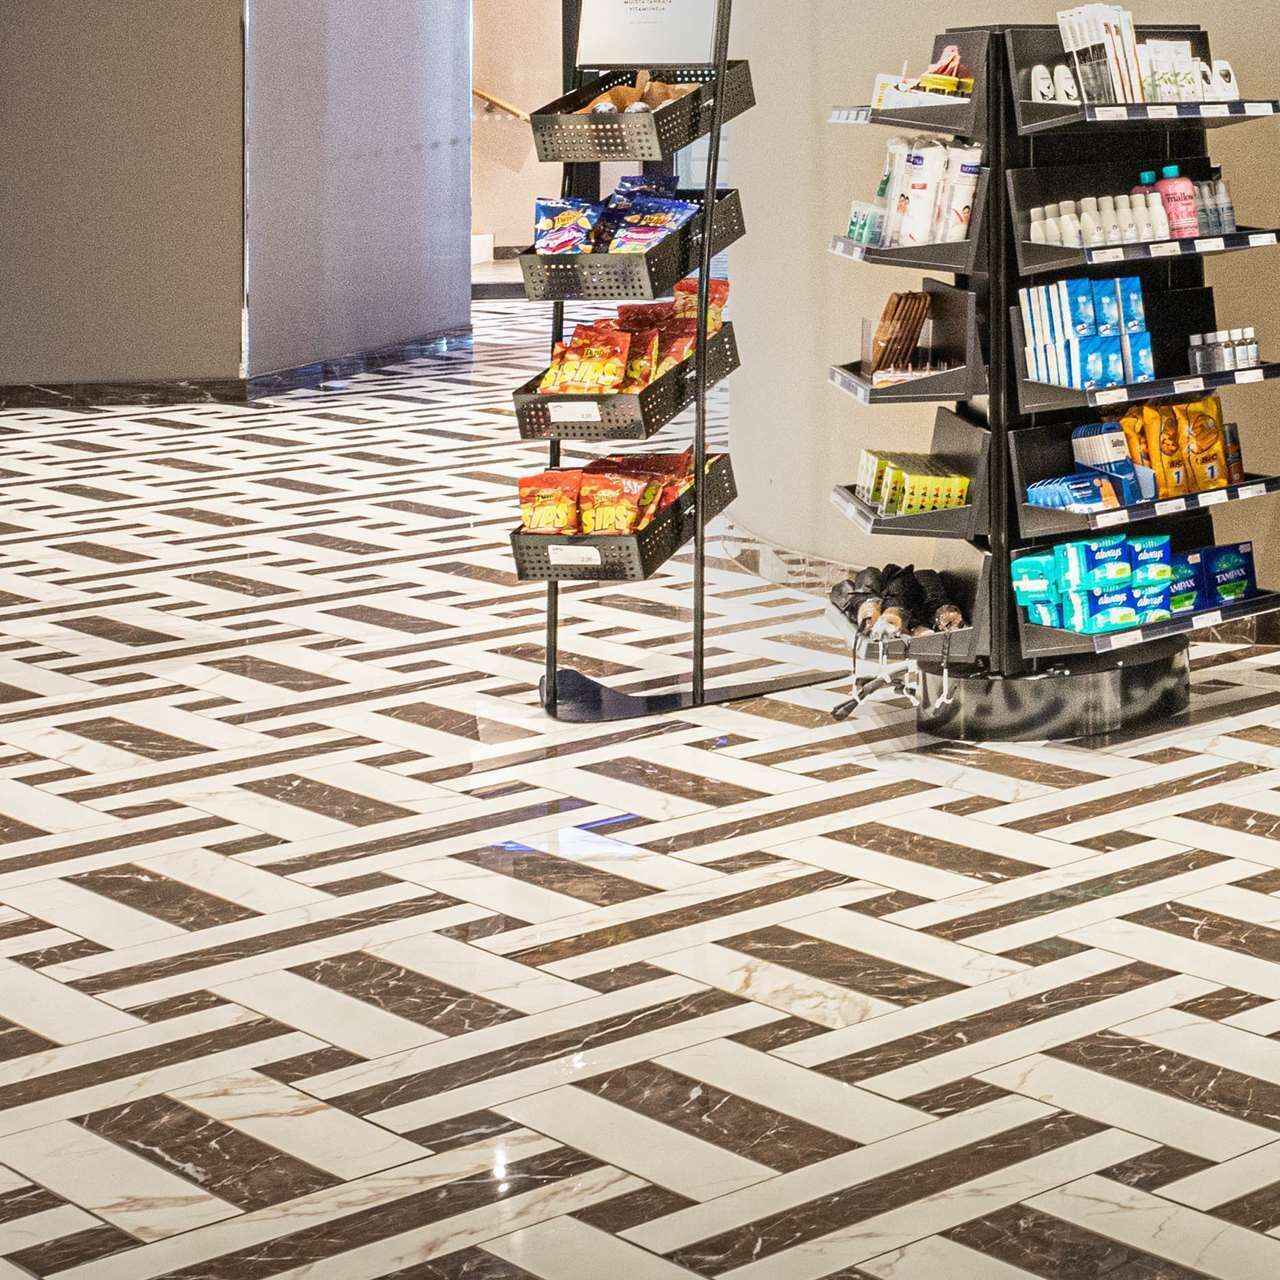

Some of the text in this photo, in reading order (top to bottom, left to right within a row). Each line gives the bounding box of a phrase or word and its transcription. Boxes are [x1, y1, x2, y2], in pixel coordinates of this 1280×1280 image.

[1201, 453, 1218, 464] BIC
[1174, 470, 1181, 484] 1
[1208, 465, 1216, 479] 1
[582, 505, 636, 534] SIPS
[1095, 548, 1122, 560] always
[1138, 548, 1164, 561] always
[1216, 567, 1247, 584] TAMPAX
[1169, 579, 1196, 593] AMPAX
[1098, 592, 1127, 605] always
[1137, 594, 1164, 607] always
